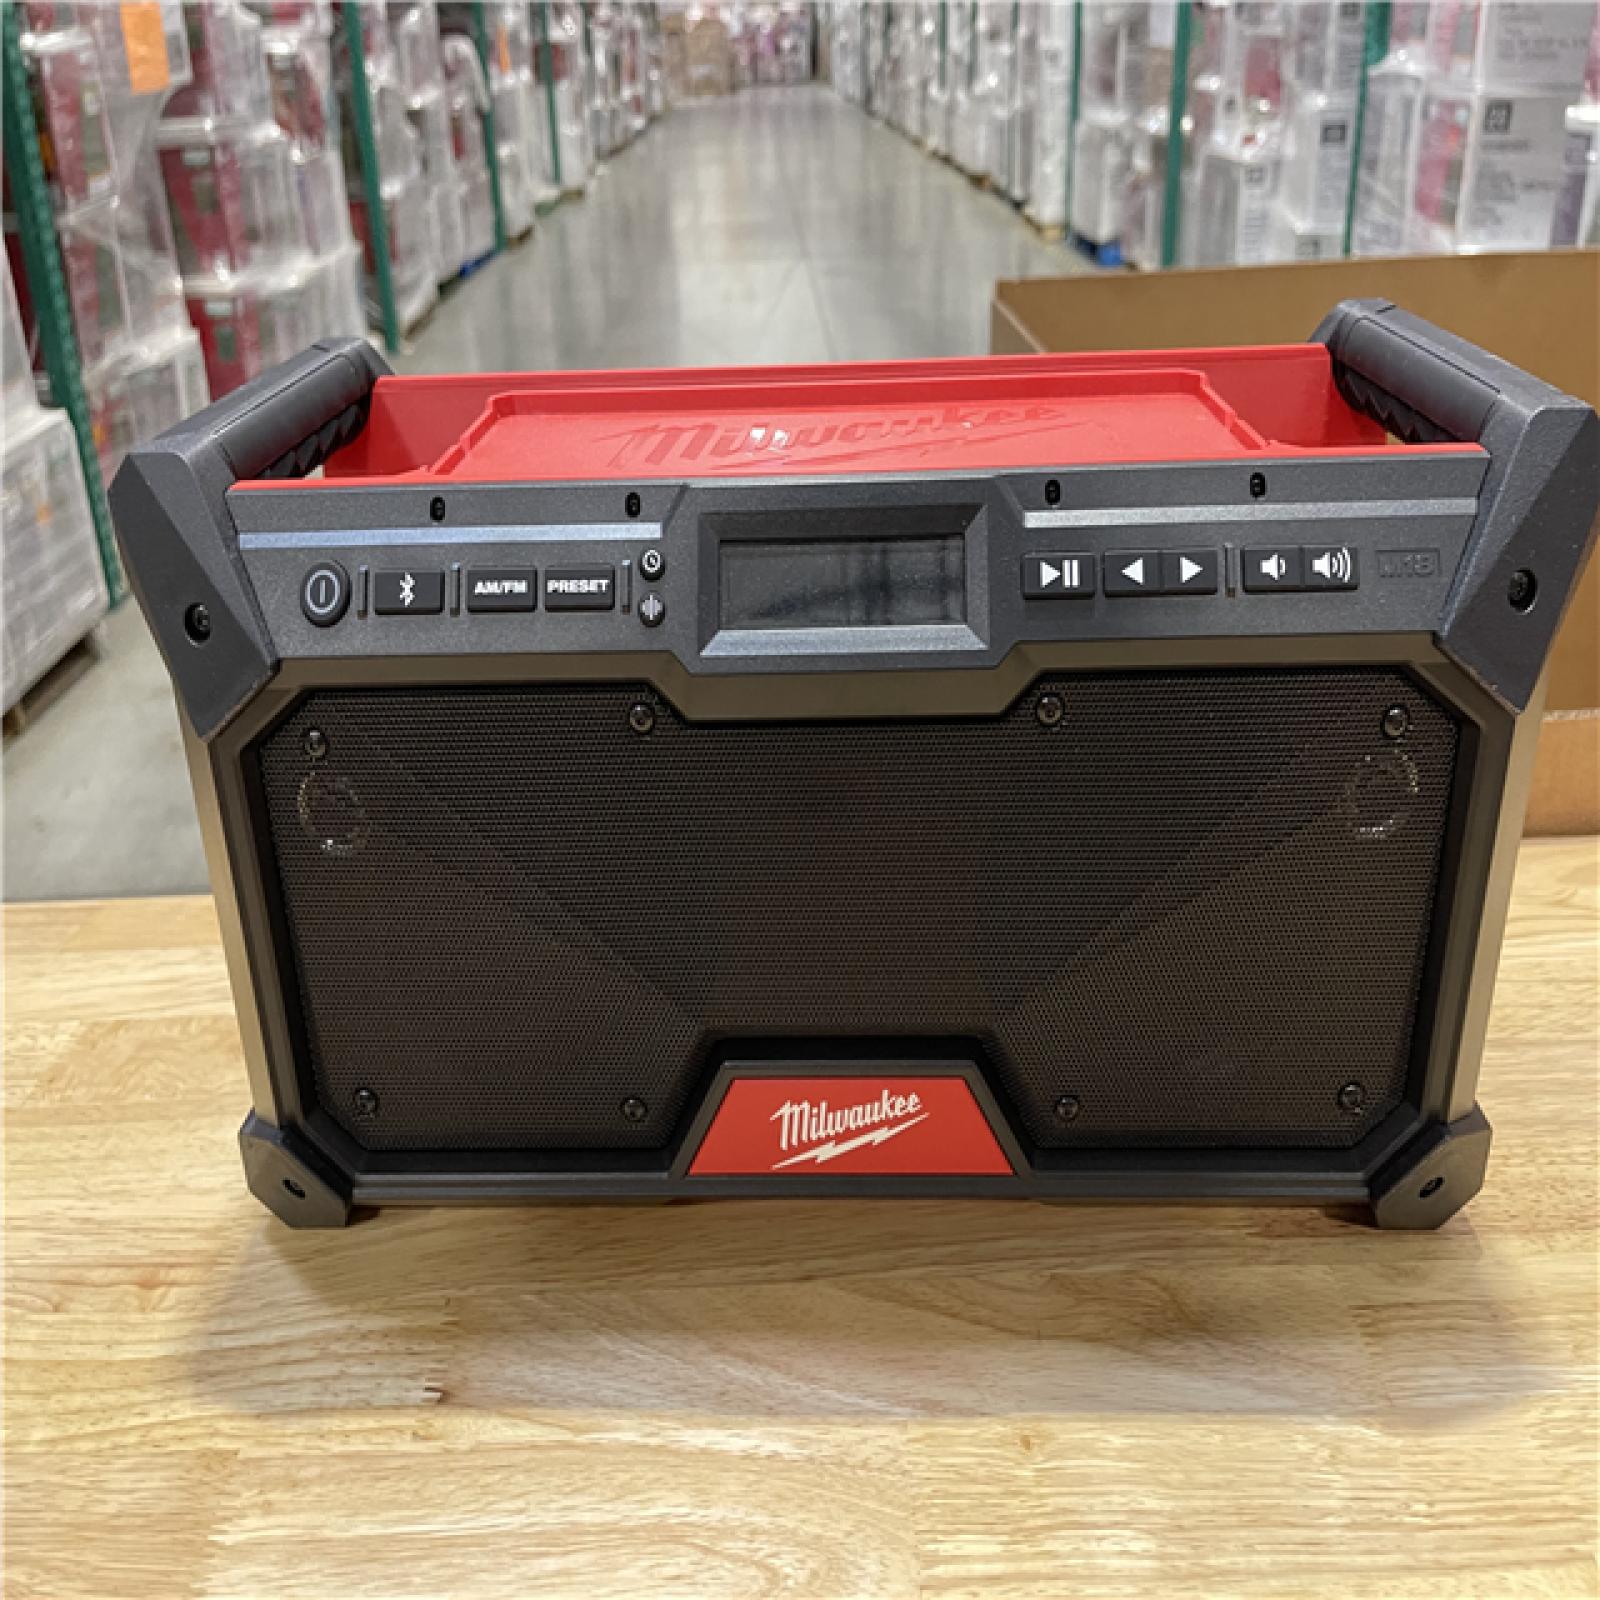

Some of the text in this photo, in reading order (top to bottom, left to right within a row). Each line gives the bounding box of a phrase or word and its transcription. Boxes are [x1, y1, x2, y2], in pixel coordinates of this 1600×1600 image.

[594, 406, 1068, 470] Milwaukee
[474, 579, 529, 595] AM/FM
[546, 578, 611, 594] PRESET
[770, 1089, 922, 1150] Milwaukee
